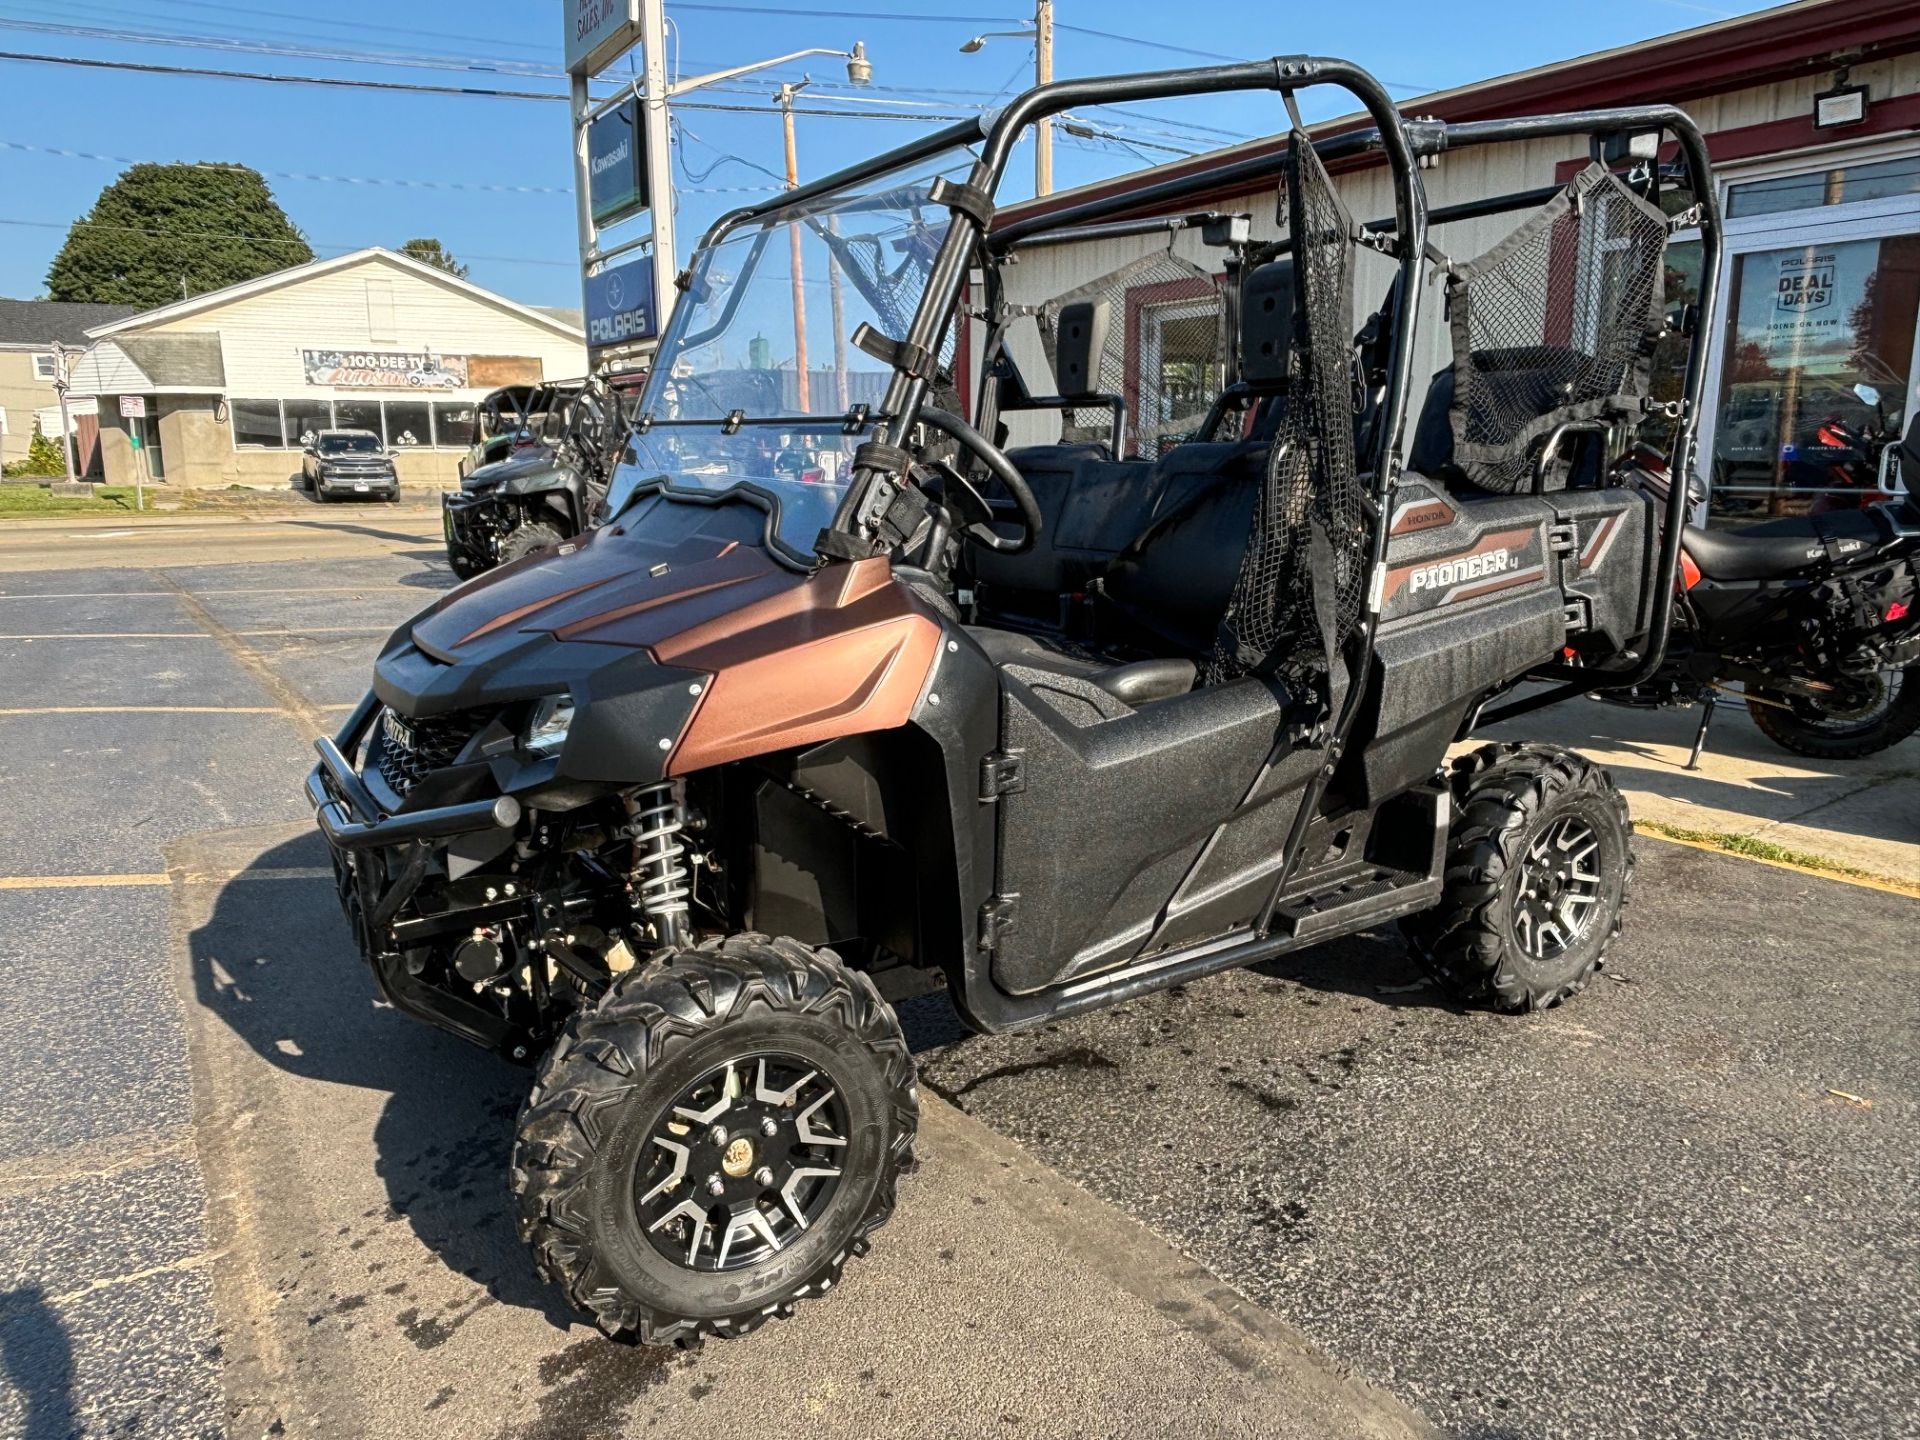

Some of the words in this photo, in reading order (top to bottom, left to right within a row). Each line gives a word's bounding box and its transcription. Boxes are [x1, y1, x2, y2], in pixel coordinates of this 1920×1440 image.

[592, 138, 628, 176] Kawasaki
[1781, 255, 1836, 267] POLARIS
[1779, 273, 1833, 292] DEAL
[1783, 291, 1825, 306] DAYS
[591, 309, 646, 342] POLARIS
[1799, 320, 1812, 328] ON
[1816, 319, 1838, 327] NOW
[1407, 511, 1446, 526] HONDA
[1409, 548, 1508, 594] PIONEER
[1509, 557, 1519, 570] 4
